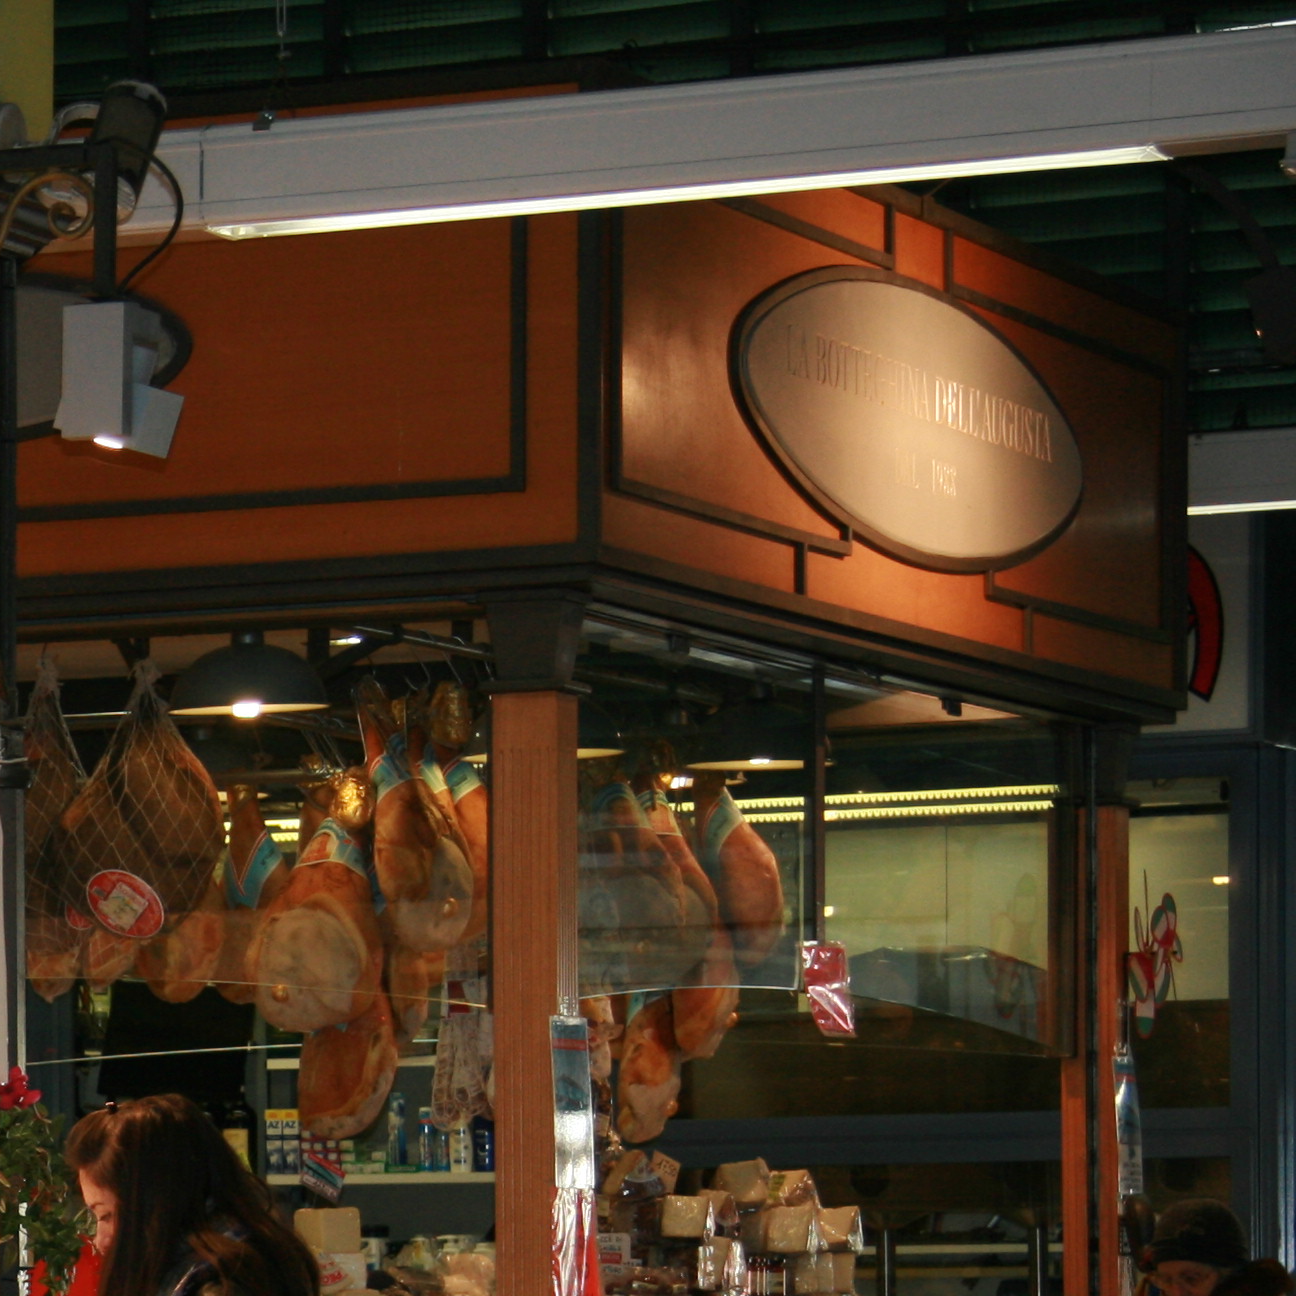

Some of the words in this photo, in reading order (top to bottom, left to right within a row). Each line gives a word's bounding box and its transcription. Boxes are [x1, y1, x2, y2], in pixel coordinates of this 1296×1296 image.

[934, 376, 1053, 463] DELL'AUGUSTA
[268, 1120, 280, 1129] AZ
[284, 1120, 296, 1129] AZ
